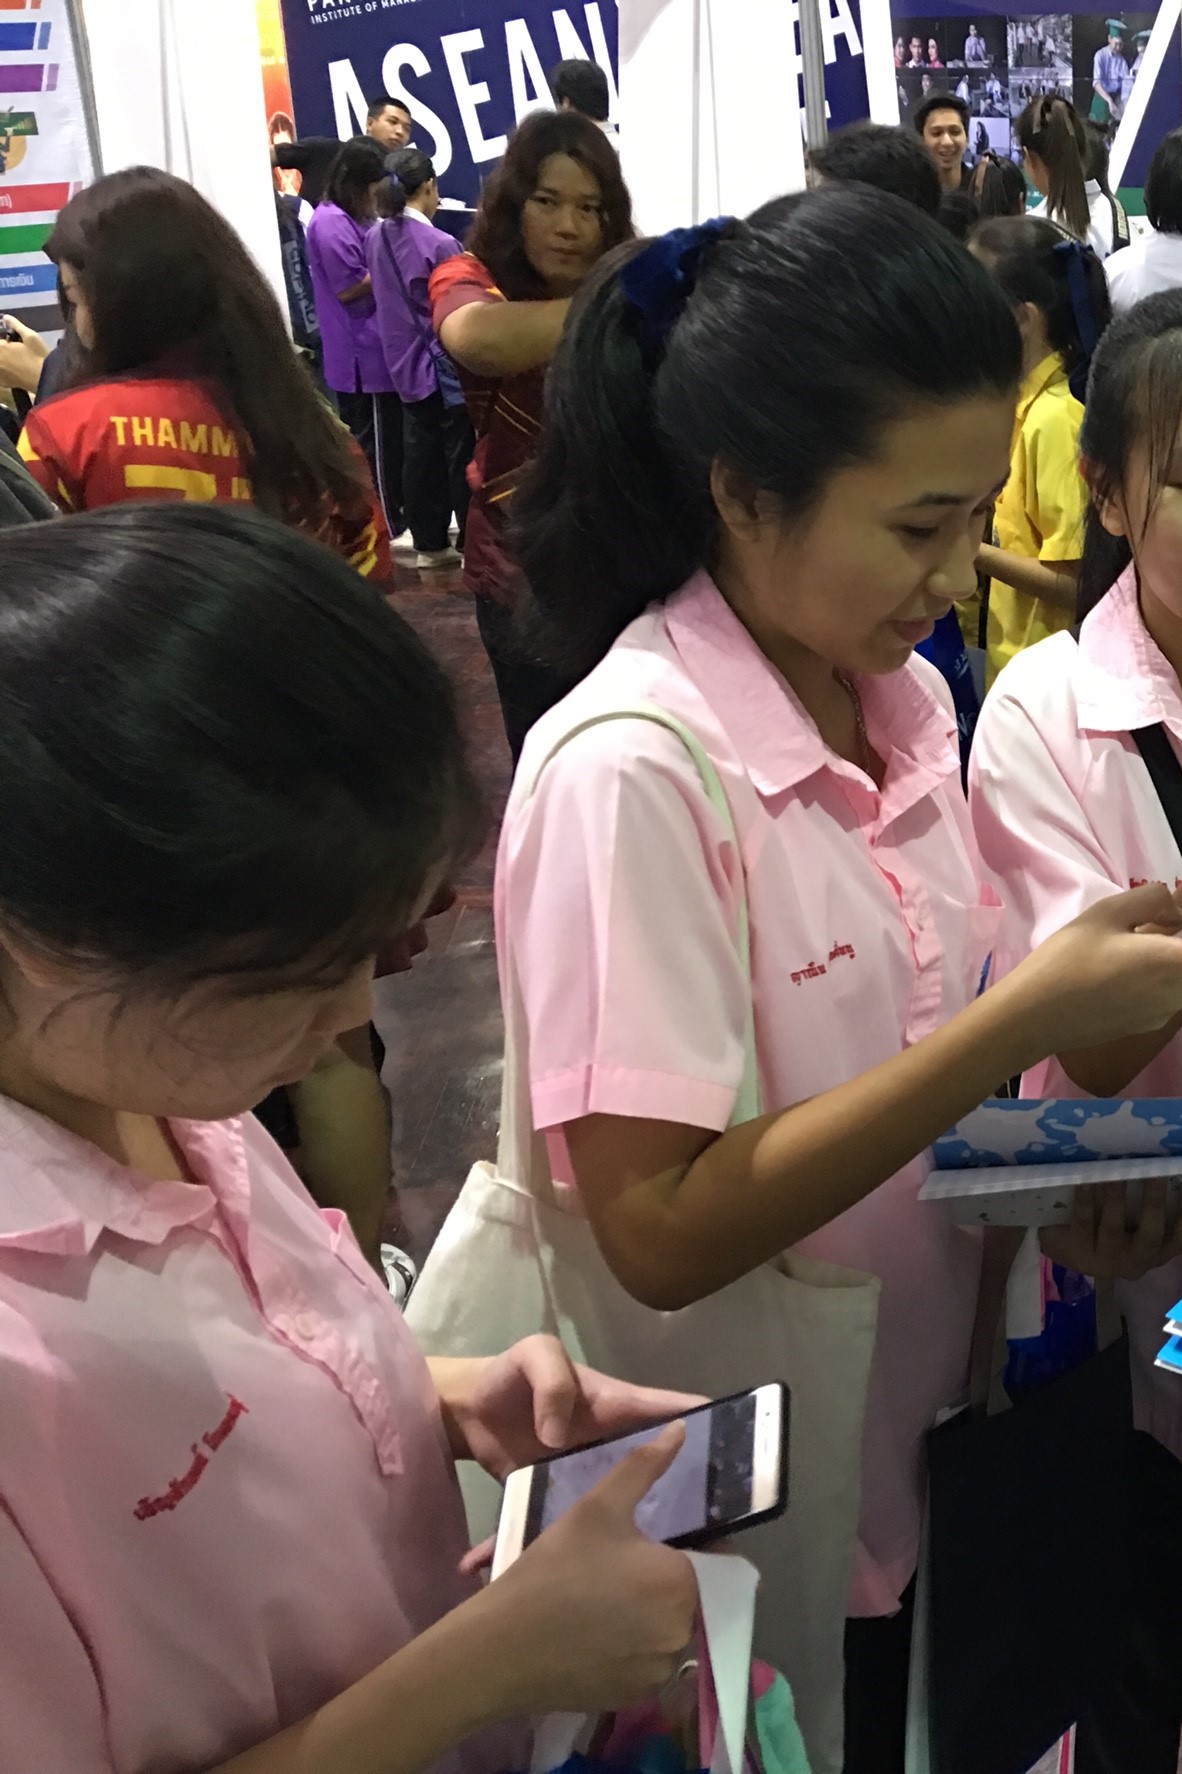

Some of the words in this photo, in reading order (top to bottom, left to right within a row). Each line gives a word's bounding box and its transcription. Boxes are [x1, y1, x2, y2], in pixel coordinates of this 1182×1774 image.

[311, 5, 362, 24] INSTITUTE
[365, 2, 378, 12] OF
[110, 416, 240, 457] THAMM
